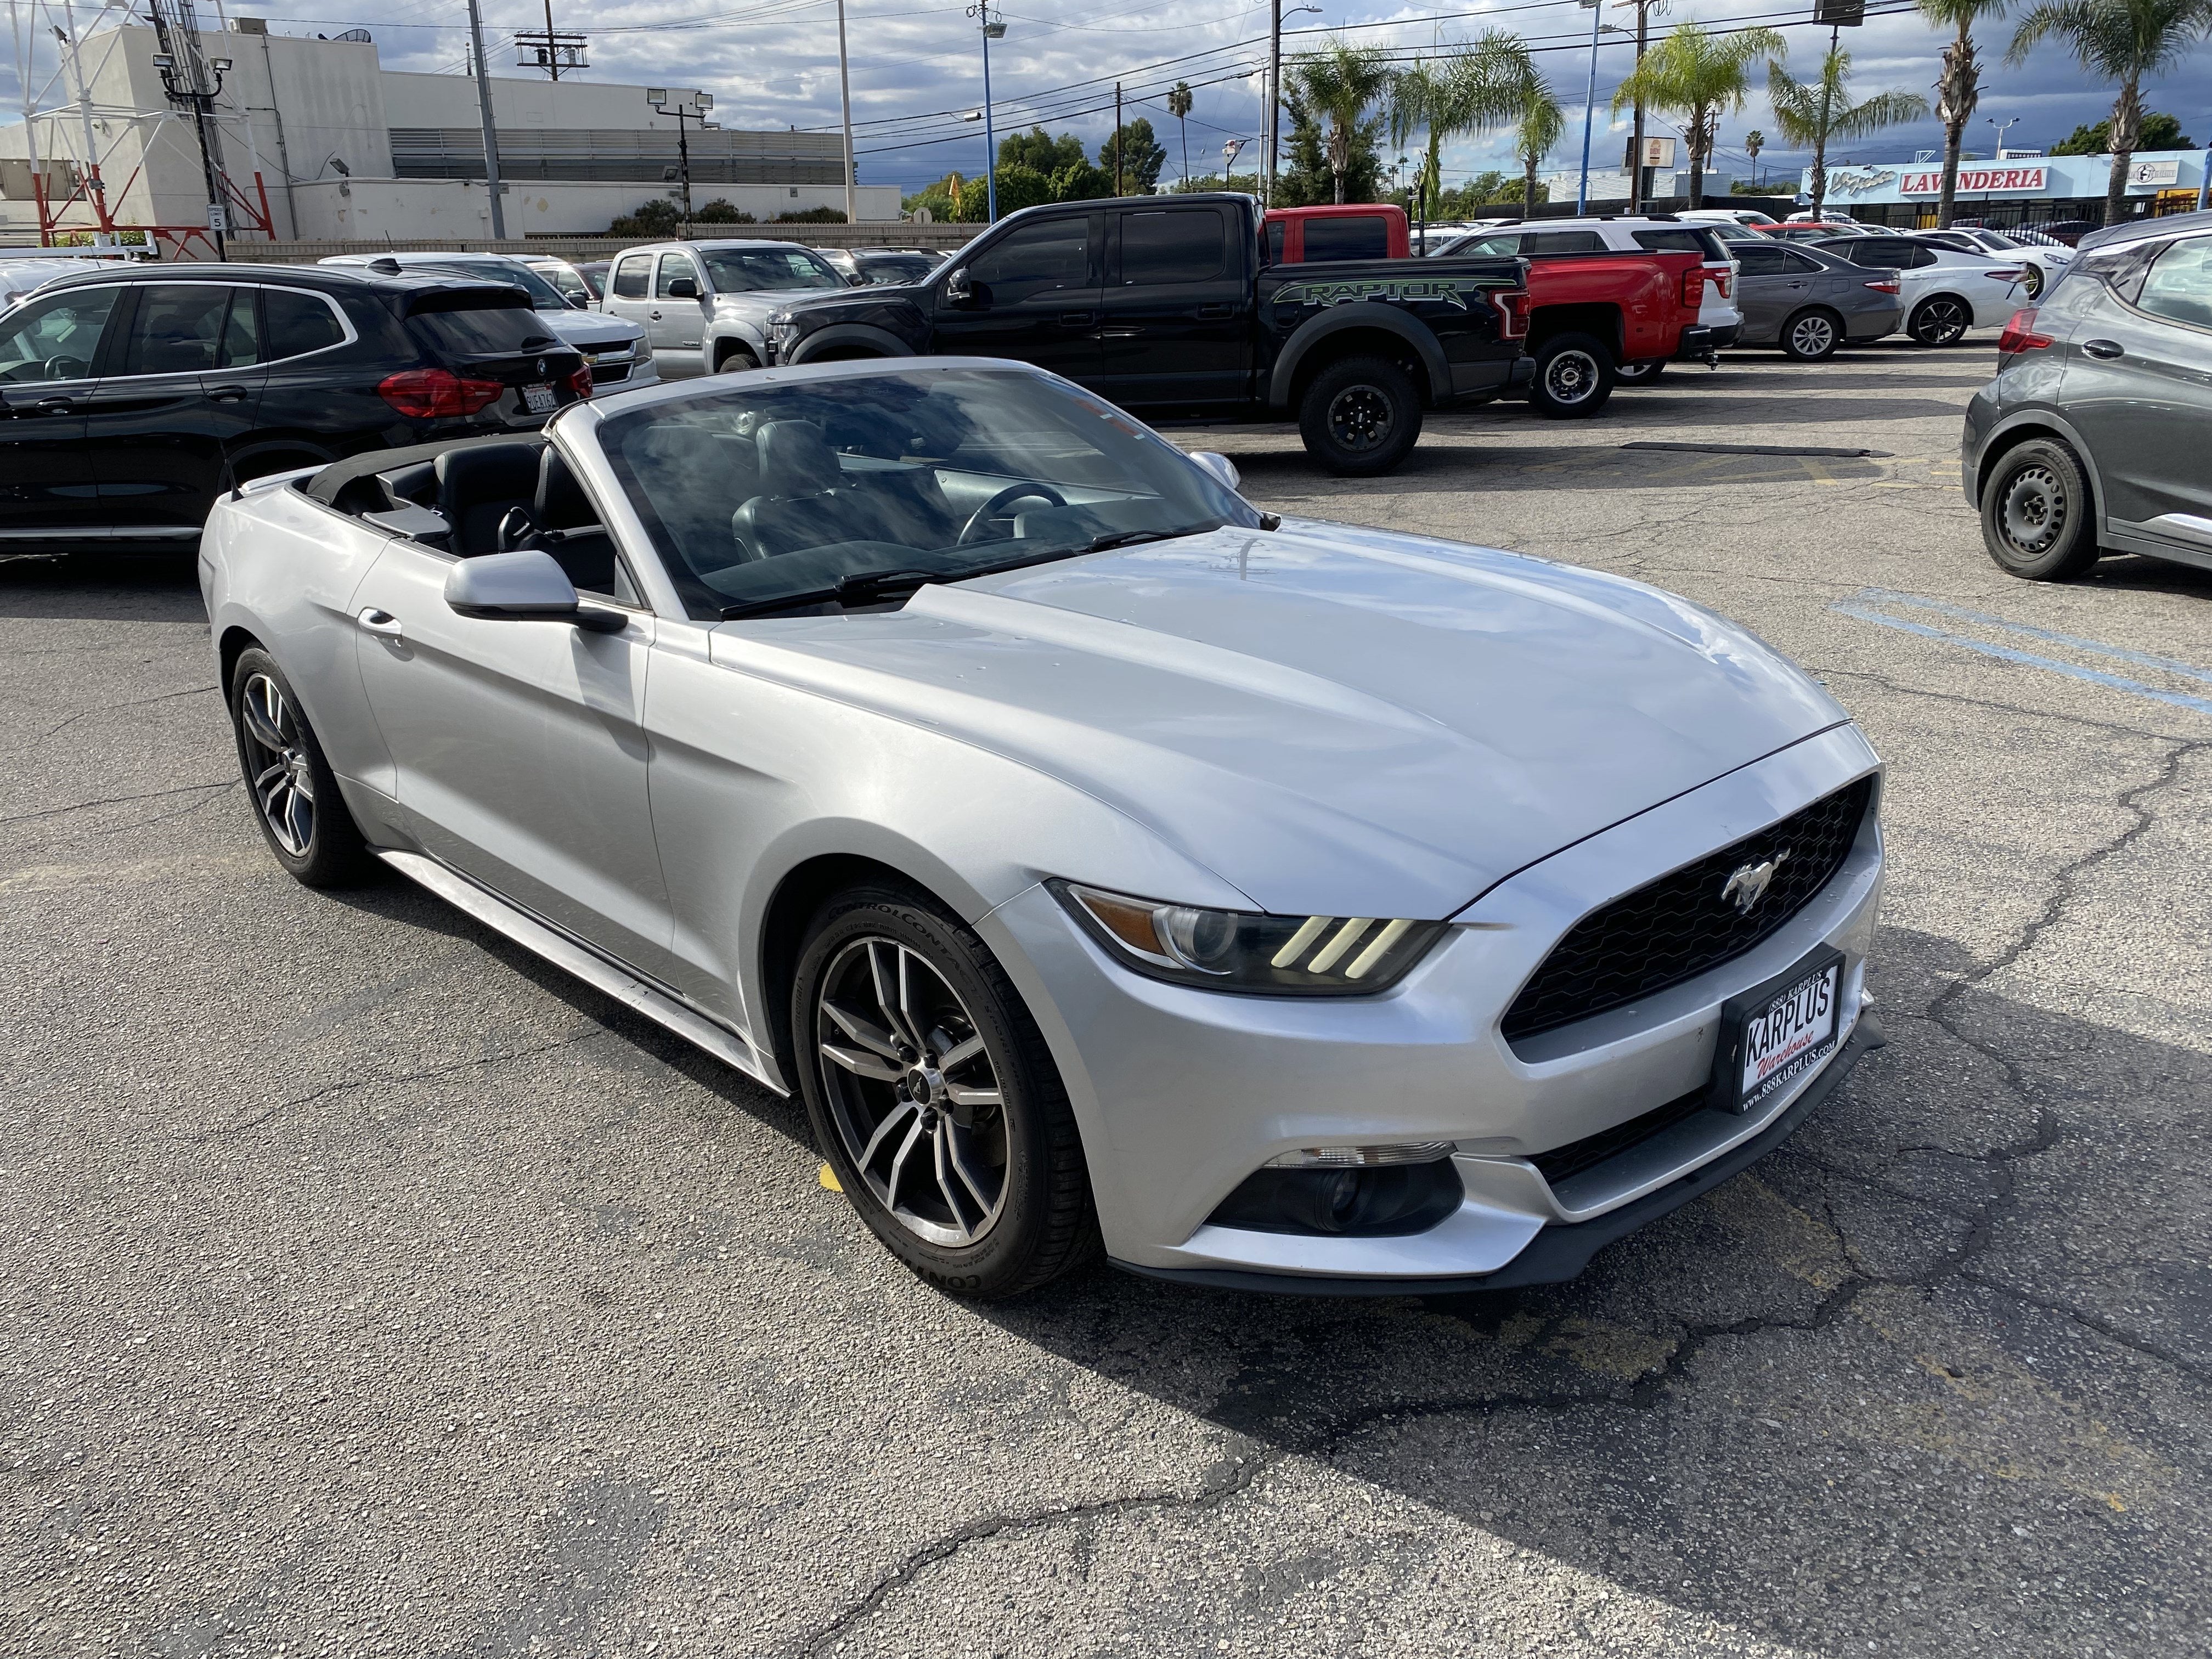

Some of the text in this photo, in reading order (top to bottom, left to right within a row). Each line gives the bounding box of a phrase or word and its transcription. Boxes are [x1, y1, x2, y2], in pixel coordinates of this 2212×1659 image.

[1901, 169, 2043, 192] LAVNDERIA
[214, 218, 221, 227] 5
[1304, 279, 1466, 311] RAPTOR
[1768, 969, 1823, 1013] (888) KARPLUS
[1746, 977, 1831, 1068] KARPLUS
[1757, 1030, 1814, 1080] Warehouse
